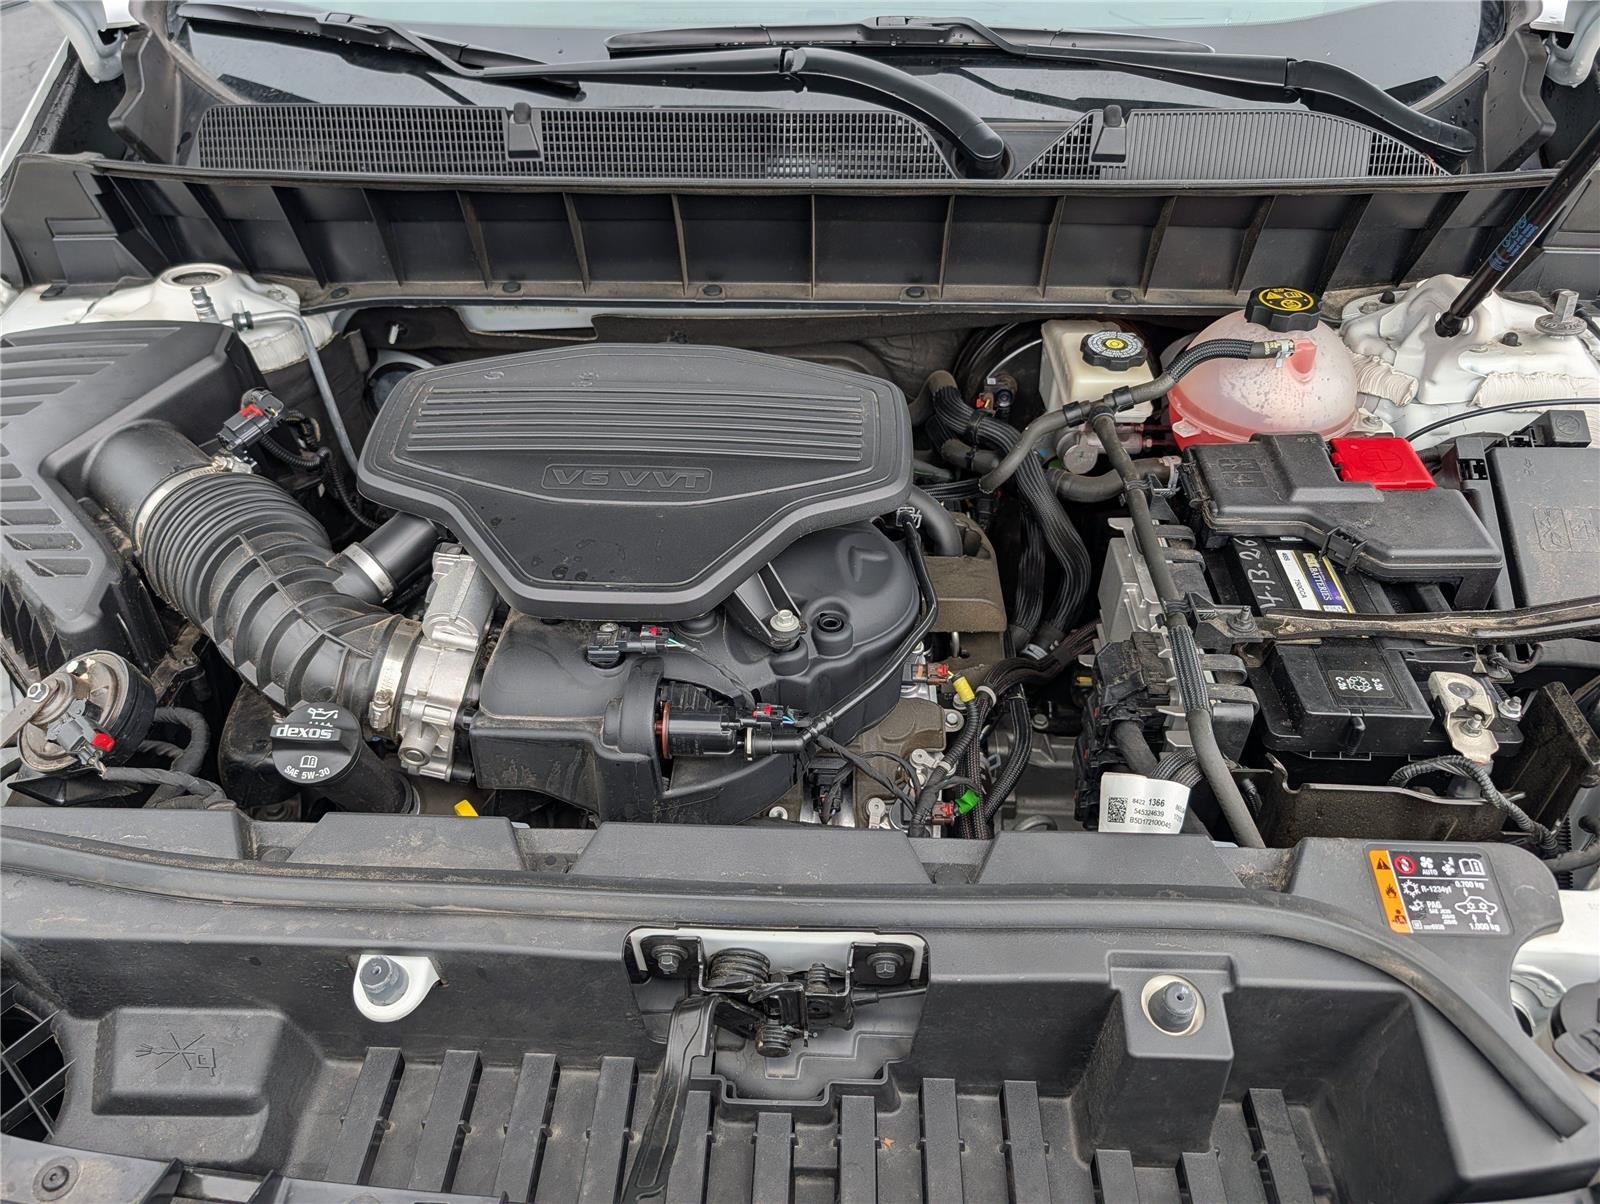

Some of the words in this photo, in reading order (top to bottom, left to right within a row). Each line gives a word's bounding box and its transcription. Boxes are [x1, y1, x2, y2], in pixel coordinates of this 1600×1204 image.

[552, 469, 609, 486] V6
[619, 471, 705, 488] VVT
[1309, 567, 1332, 600] BATTERIES
[276, 725, 334, 739] dexos
[284, 765, 300, 778] SAE
[301, 767, 331, 780] 5W-30
[1455, 880, 1474, 888] 0.700
[1475, 881, 1485, 889] kg
[1490, 923, 1500, 932] kg
